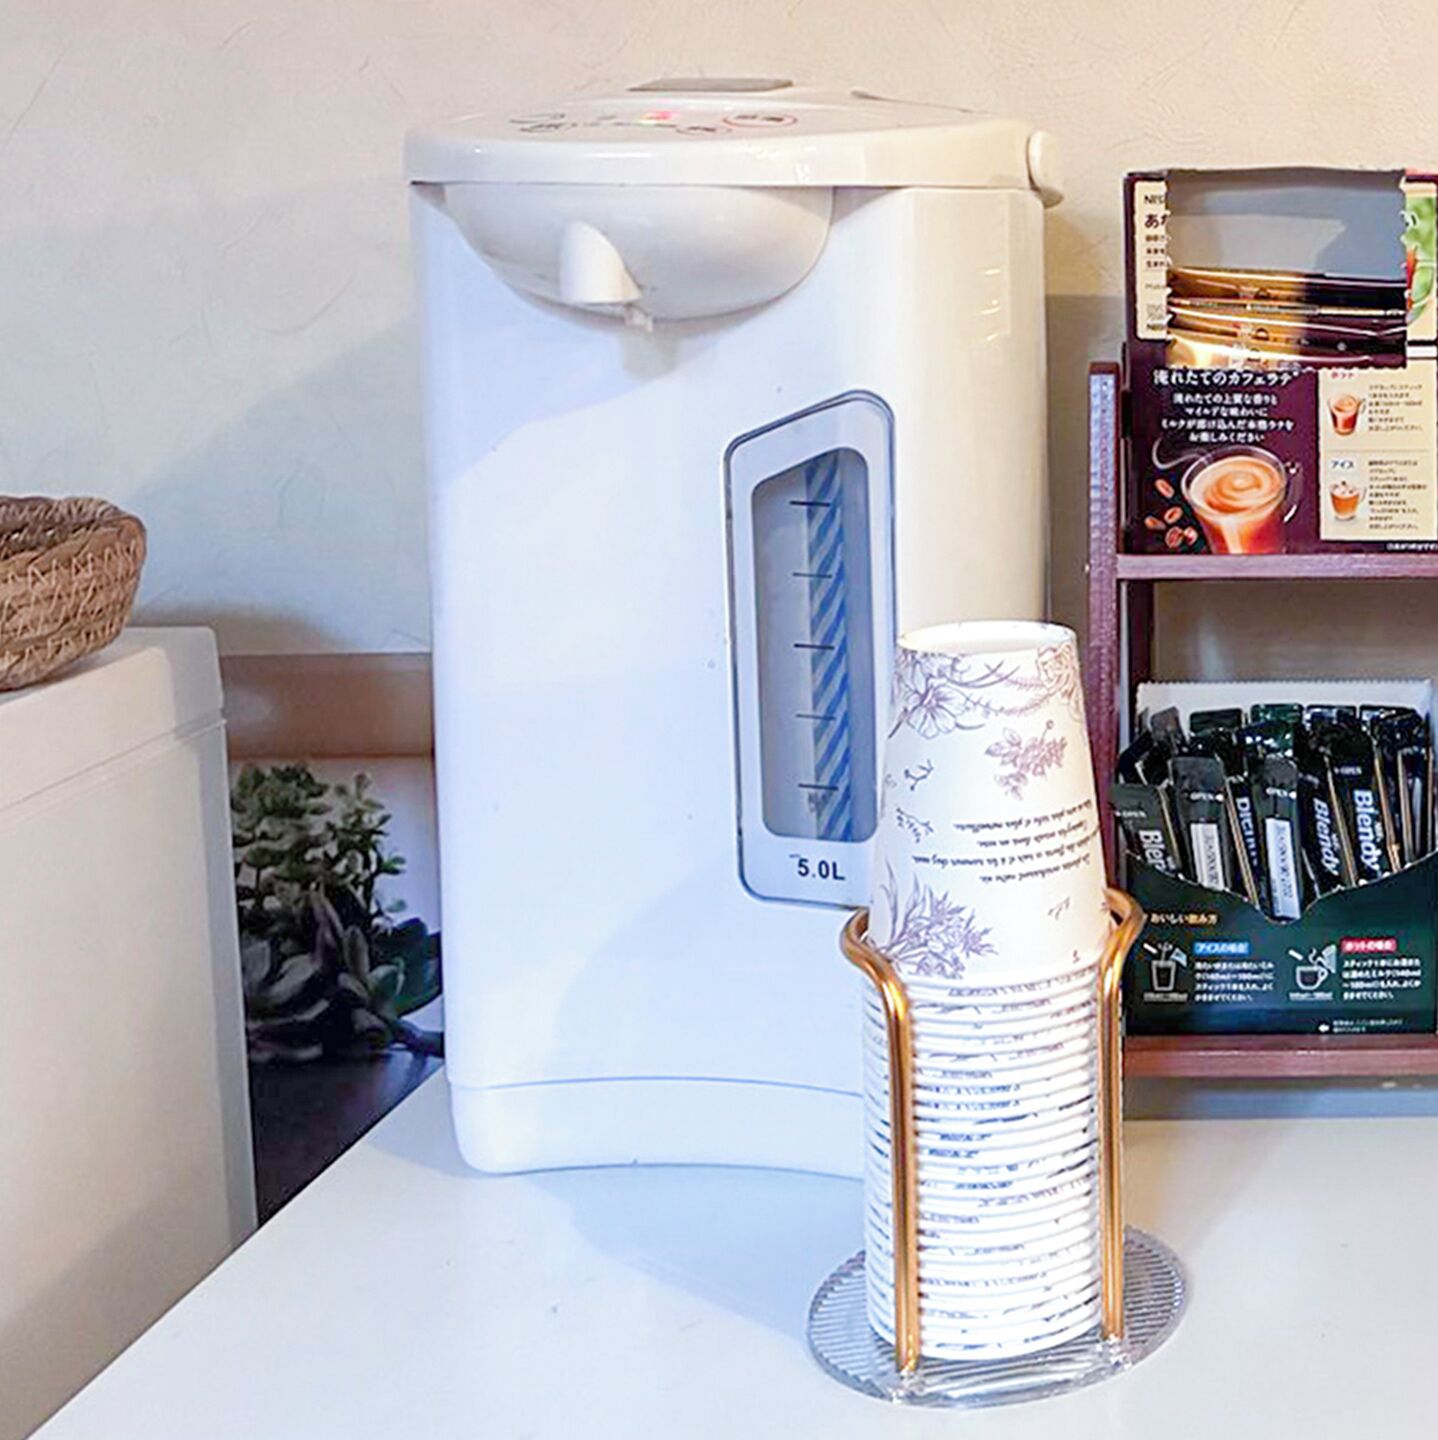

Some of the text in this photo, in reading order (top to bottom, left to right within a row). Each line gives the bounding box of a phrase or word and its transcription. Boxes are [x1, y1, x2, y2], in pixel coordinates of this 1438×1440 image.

[797, 858, 846, 880] 5.0L
[1313, 797, 1340, 877] Blendy
[1353, 789, 1382, 872] Blendy
